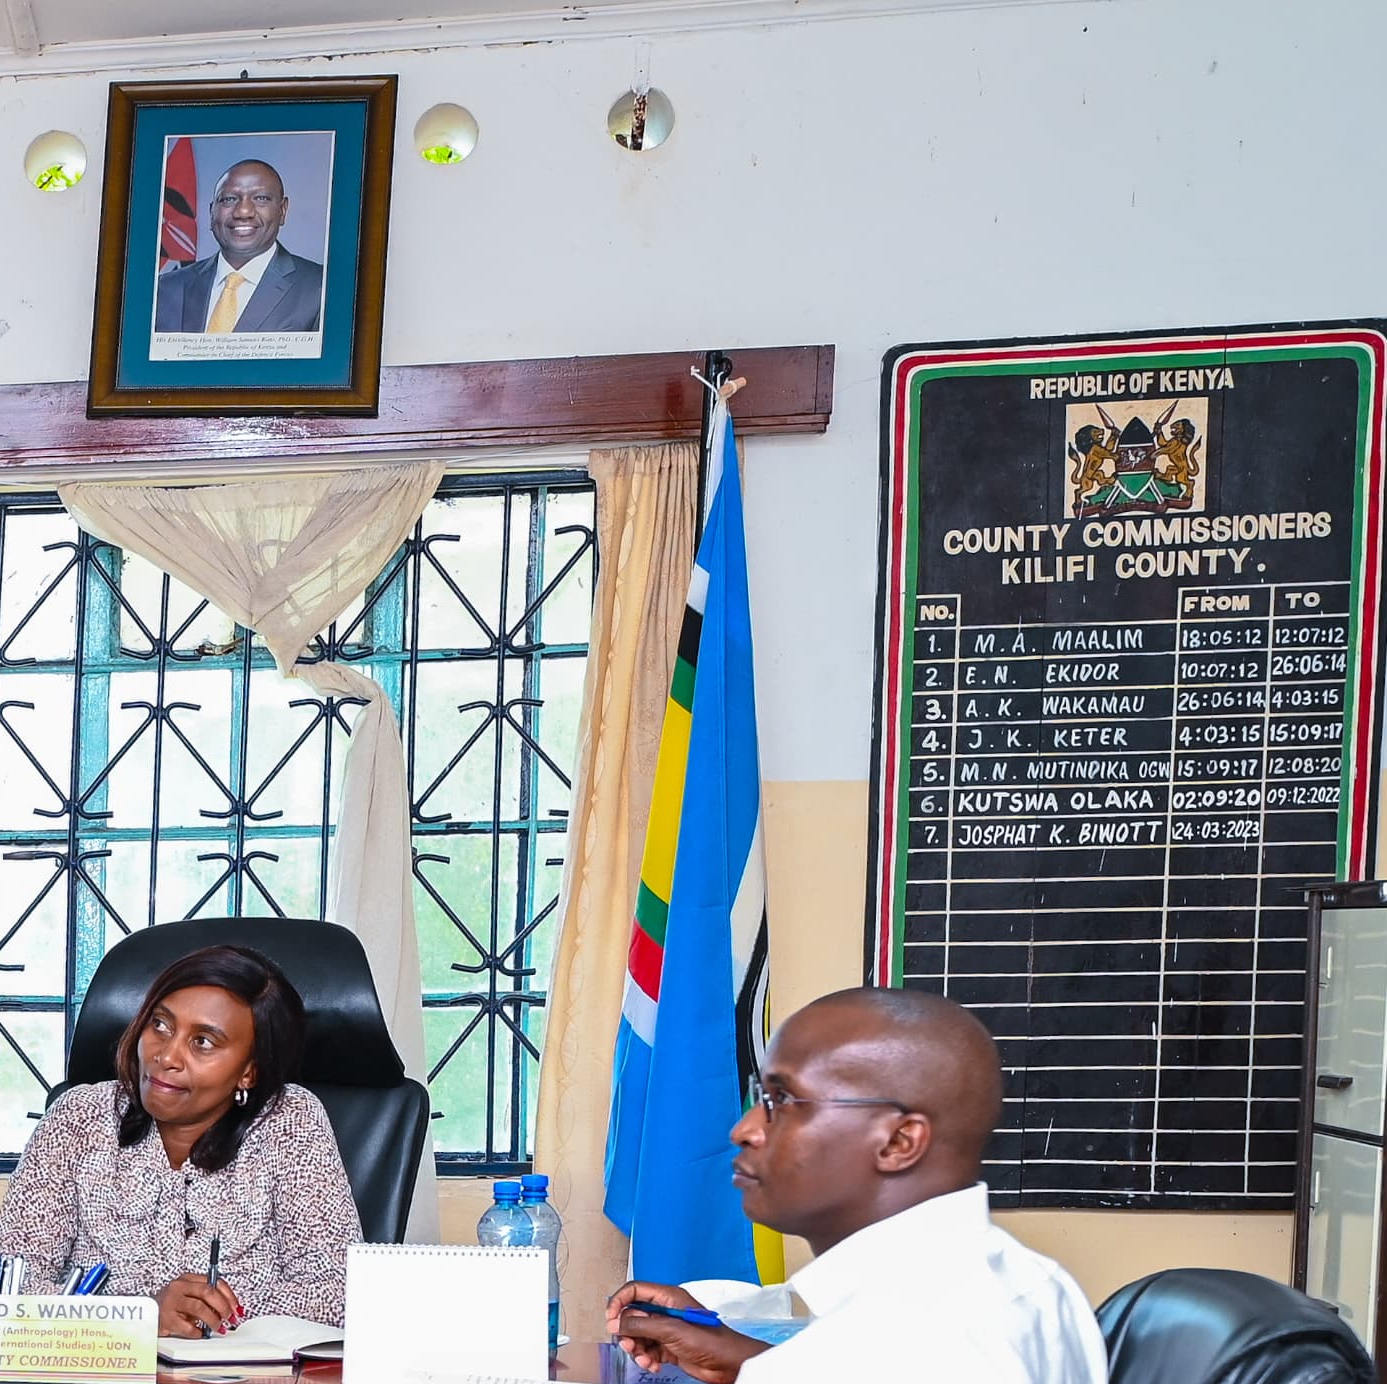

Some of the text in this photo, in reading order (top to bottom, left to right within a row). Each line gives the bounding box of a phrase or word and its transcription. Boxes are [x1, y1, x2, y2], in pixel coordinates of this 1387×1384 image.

[1030, 368, 1235, 400] REPUBLIC OF KENYA
[943, 511, 1332, 556] COUNTY COMMISSIONERS
[1002, 555, 1095, 584] KILIFI
[920, 592, 1321, 621] NO. FROM TO
[928, 634, 942, 653] 1.
[1052, 629, 1144, 651] MAALIM
[1275, 627, 1345, 644] 12:07:12
[925, 667, 942, 687] 2.
[1046, 663, 1120, 683] EKIDOR
[1181, 663, 1259, 679] 10:07:12
[1272, 653, 1346, 676] 26:06:14
[925, 699, 947, 721] 3.
[1042, 695, 1145, 716] WAKAMAU
[1178, 691, 1266, 711] 26:06:14
[1272, 689, 1339, 708] 4:03:15
[922, 730, 947, 752] 4.
[1054, 727, 1128, 747] KETER
[1179, 724, 1261, 747] 4:03:15
[1270, 723, 1344, 742] 15:09:17
[922, 762, 945, 782] 5.
[1138, 761, 1170, 779] OGW
[1178, 759, 1259, 777] 15:09:17
[1268, 757, 1341, 774] 12:08:20
[920, 787, 1340, 813] 6. KUTSWA OLAKA 02:09:20 09:12:2022
[924, 820, 1260, 845] 7. JOSPHAT K. BIWOTT 24:03:2023
[16, 1303, 31, 1318] S.
[37, 1304, 143, 1320] WANYONYI
[2, 1326, 78, 1339] (Anthropology)
[56, 1340, 96, 1351] Studies)
[106, 1342, 131, 1351] UON
[19, 1355, 137, 1369] COMMISSIONER
